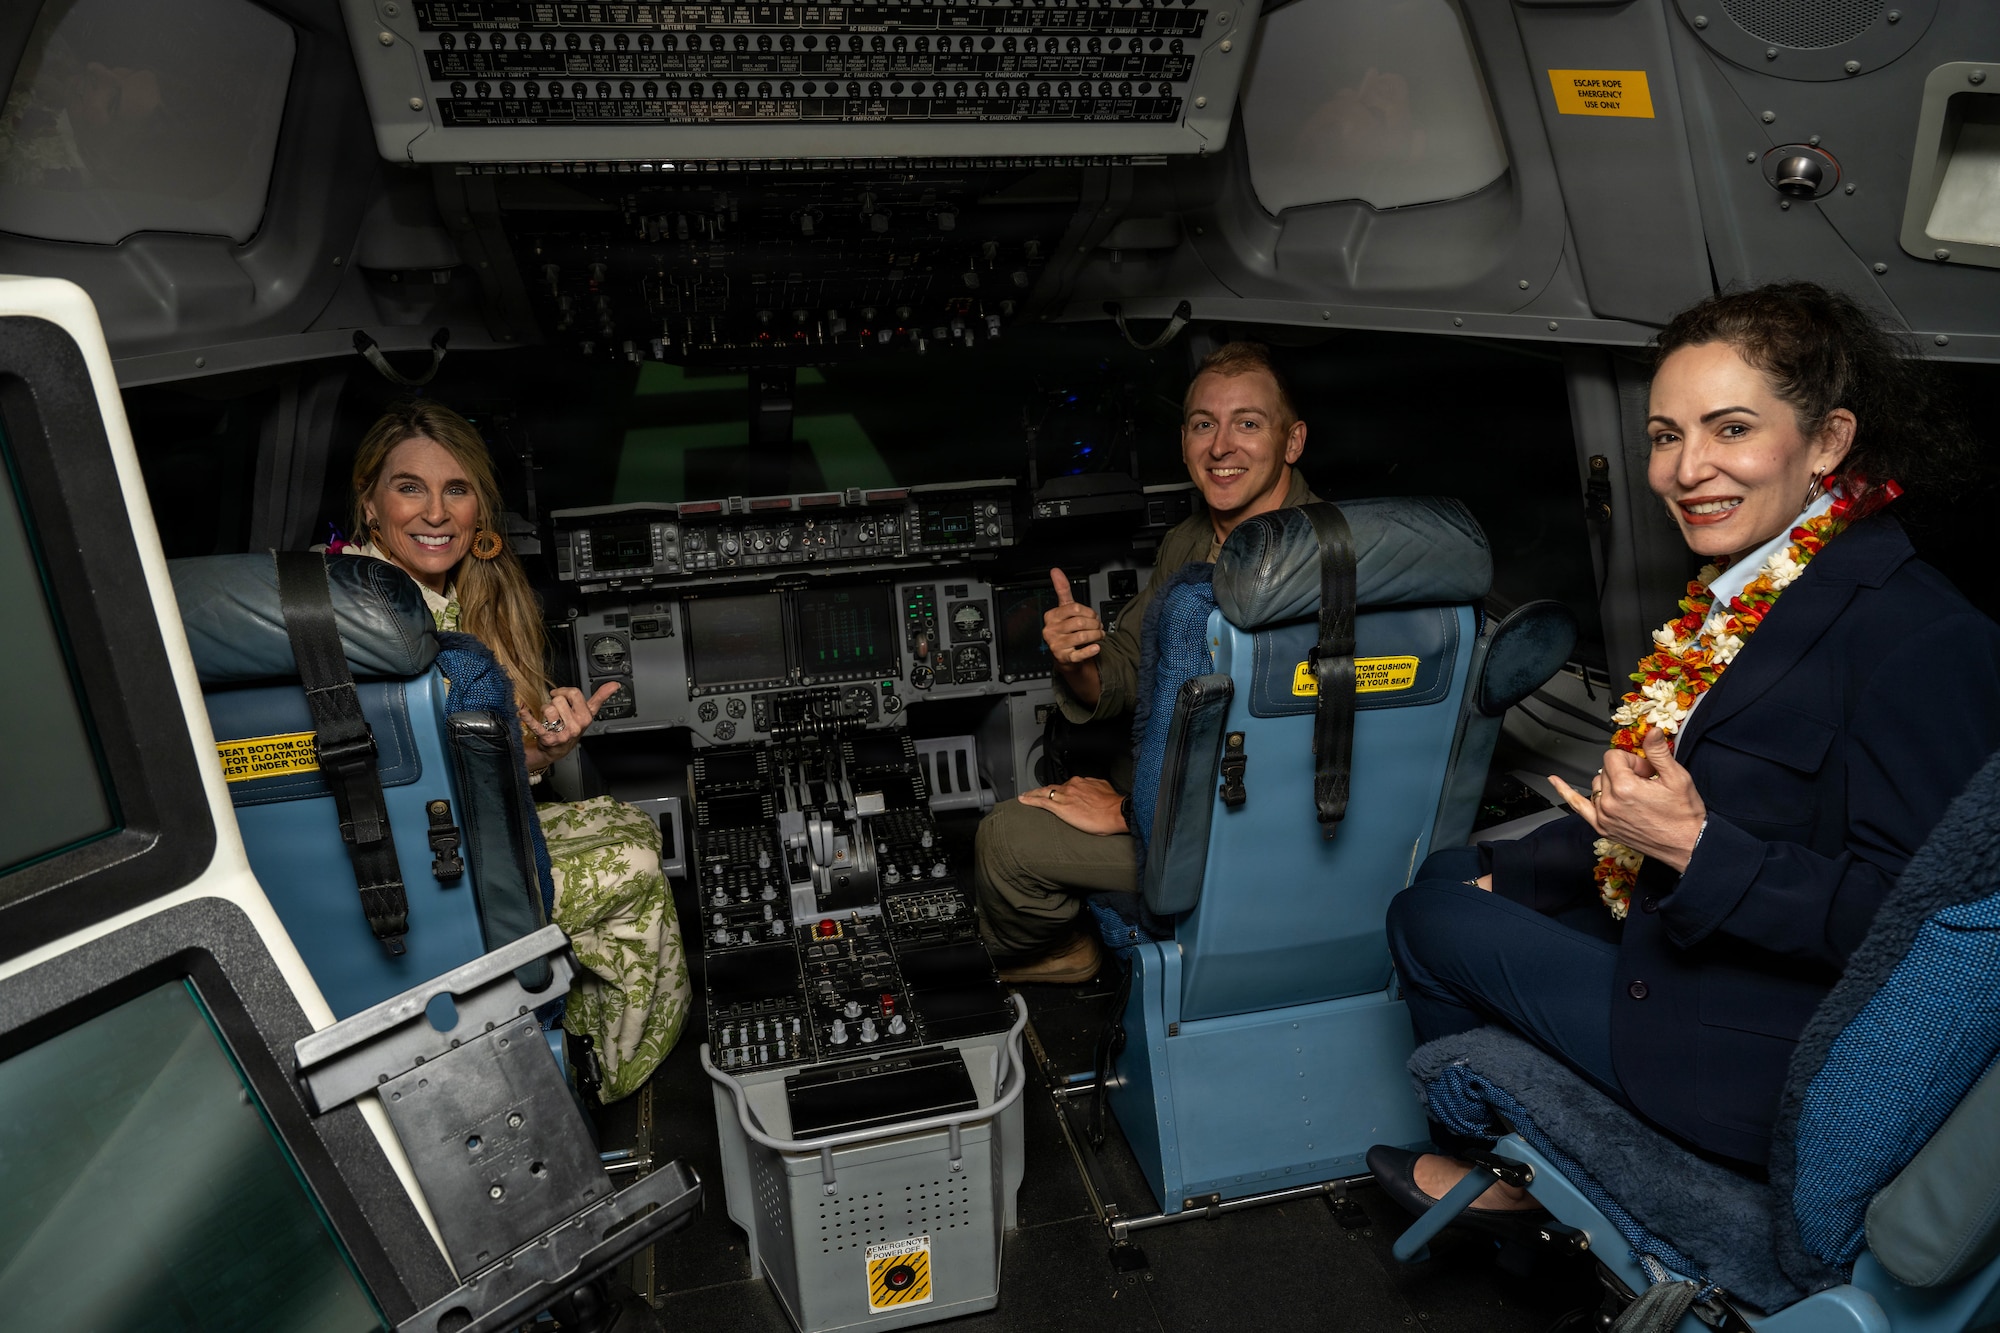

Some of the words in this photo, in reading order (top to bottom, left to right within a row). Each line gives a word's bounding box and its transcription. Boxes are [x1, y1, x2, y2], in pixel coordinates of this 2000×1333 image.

[1603, 80, 1622, 88] ROPE
[1578, 90, 1622, 98] EMERGENCY
[1376, 663, 1412, 671] CUSHION
[1368, 678, 1389, 686] YOUR
[248, 742, 294, 754] BOTTOM
[226, 757, 249, 766] FOR
[251, 748, 316, 763] FLOATATION
[252, 760, 290, 772] UNDER
[1540, 1230, 1551, 1241] R
[872, 1238, 922, 1253] EMERGENCY
[873, 1249, 902, 1259] POWER
[905, 1246, 920, 1254] OFF
